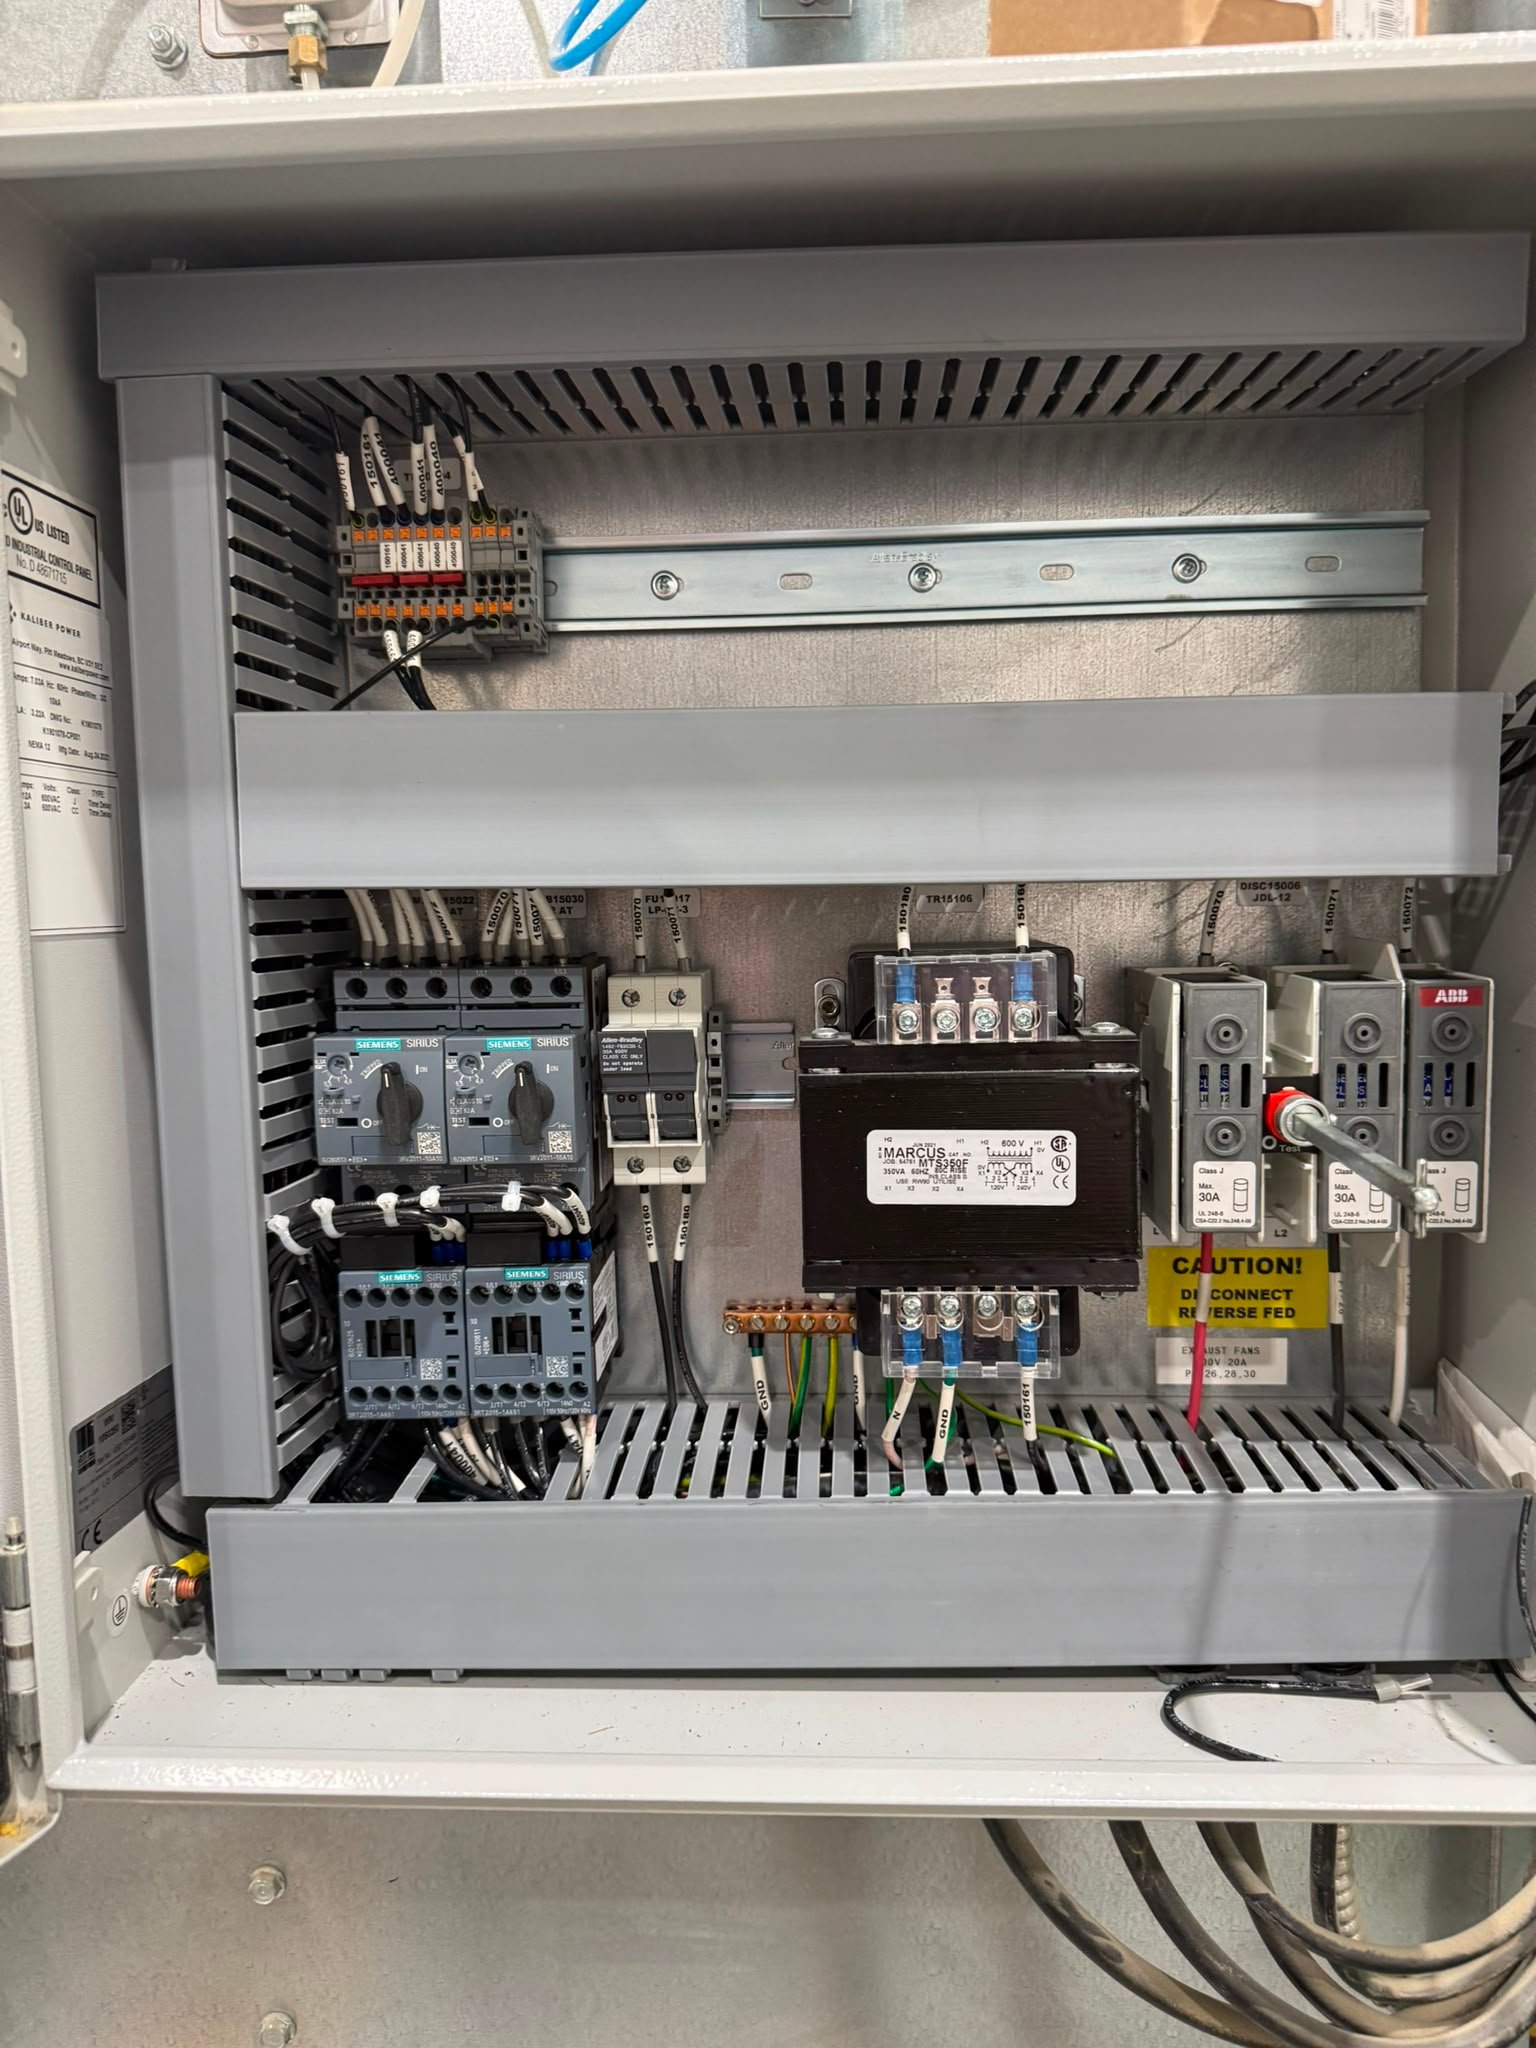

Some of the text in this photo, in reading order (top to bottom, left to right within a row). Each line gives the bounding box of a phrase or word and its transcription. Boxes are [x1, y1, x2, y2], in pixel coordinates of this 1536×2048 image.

[363, 433, 378, 488] 150161
[430, 441, 443, 495] 400040
[46, 523, 70, 545] LISTED
[12, 537, 48, 562] INDUSTRIAL
[48, 553, 77, 575] CONTROL
[75, 563, 93, 581] PANEL
[20, 611, 81, 638] KALIBER POWER
[645, 894, 690, 903] FU117
[926, 894, 973, 904] TR15106
[1253, 893, 1291, 902] JDL-12
[486, 891, 509, 936] 150070
[648, 905, 688, 914] LP--3
[898, 886, 911, 932] 150180
[1206, 890, 1225, 937] 150070
[1324, 889, 1339, 934] 150071
[1403, 886, 1414, 933] 150072
[632, 897, 642, 940] 150070
[667, 905, 681, 943] 150071
[1435, 989, 1469, 1003] ABB
[356, 1039, 438, 1049] SIEMENS SIRIUS
[488, 1037, 569, 1049] SIEMENS SIRIUS
[884, 1147, 946, 1158] MARCUS
[918, 1158, 969, 1168] MTS350F
[1199, 1192, 1220, 1202] 30A
[1334, 1193, 1356, 1203] 30A
[642, 1204, 654, 1248] 150160
[680, 1205, 690, 1248] 150180
[1274, 1229, 1288, 1238] L2
[1172, 1257, 1302, 1275] CAUTION!
[379, 1272, 458, 1282] SIEMENS SIRIUS
[506, 1270, 584, 1280] SIEMENS SIRIUS
[1181, 1288, 1294, 1300] DICONNECT
[1263, 1306, 1296, 1319] FED
[1182, 1346, 1260, 1355] EXAUST FANS
[1228, 1358, 1247, 1366] 20A
[756, 1379, 769, 1411] GND
[1022, 1382, 1031, 1427] 150161
[893, 1411, 900, 1421] N
[939, 1409, 949, 1439] GND
